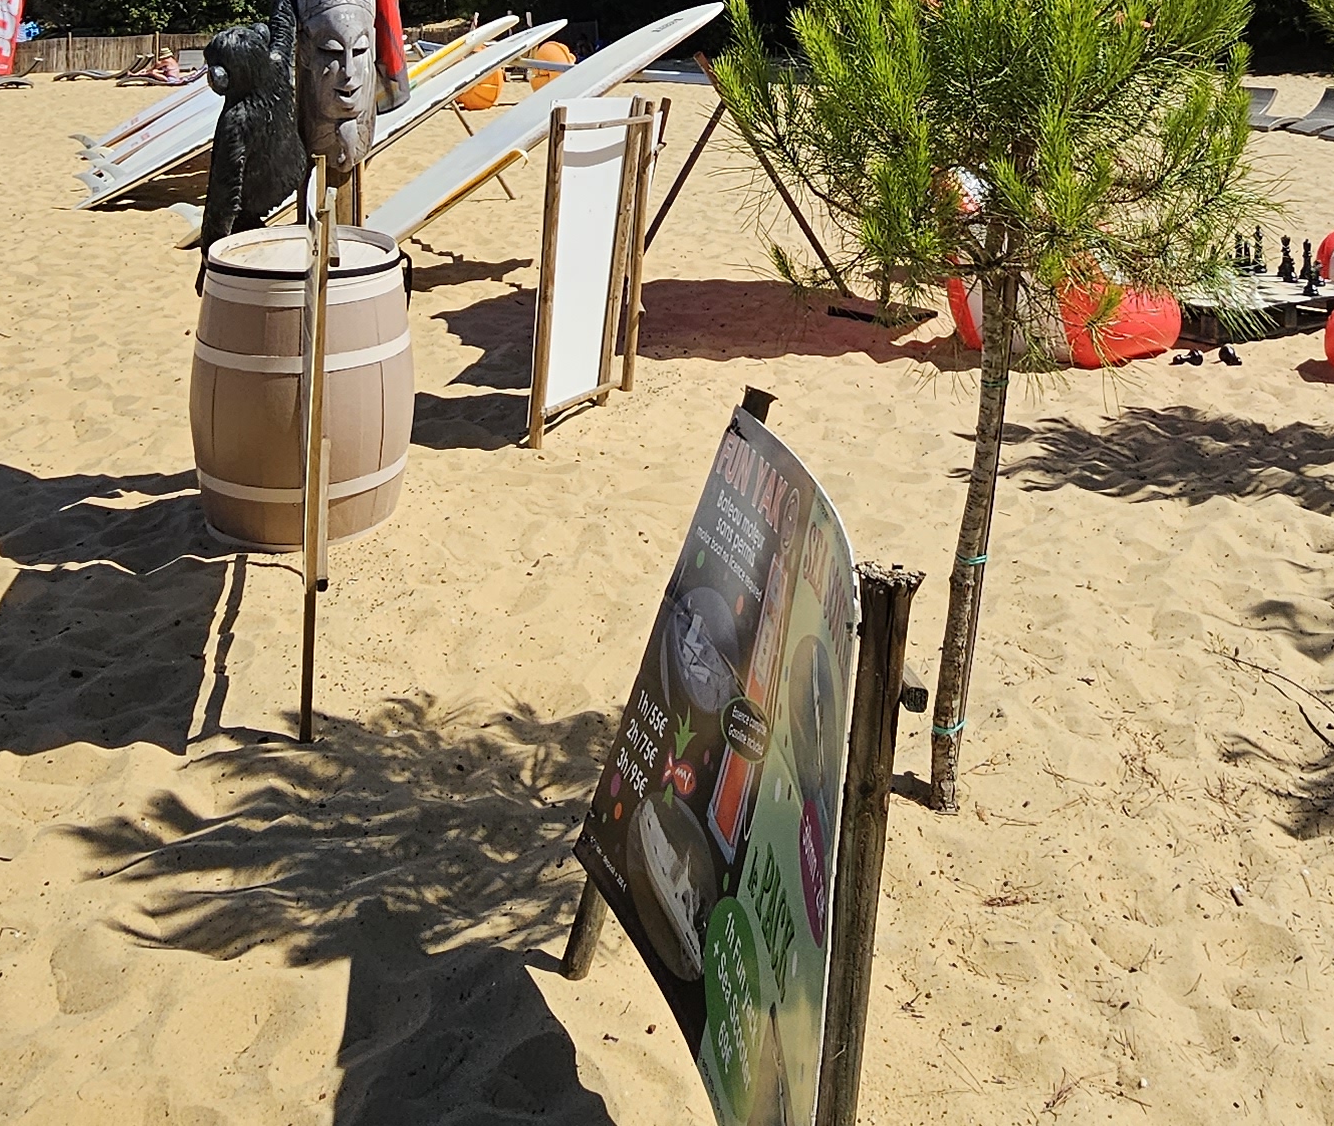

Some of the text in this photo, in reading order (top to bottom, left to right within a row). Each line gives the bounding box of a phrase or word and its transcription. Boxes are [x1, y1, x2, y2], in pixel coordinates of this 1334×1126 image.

[716, 429, 756, 497] FUN
[751, 455, 789, 534] YAK
[696, 526, 712, 546] motor
[709, 536, 724, 557] boat
[715, 517, 756, 568] sans permis
[716, 489, 766, 551] Bateau moteur
[637, 689, 669, 739] 1h/55€
[626, 718, 659, 769] 2h/75€
[616, 746, 649, 799] 3h/95€
[725, 911, 735, 949] 1h
[732, 935, 746, 992] Fun
[717, 951, 732, 1005] Sea
[729, 993, 752, 1092] Scooter
[718, 1020, 733, 1074] 69€
